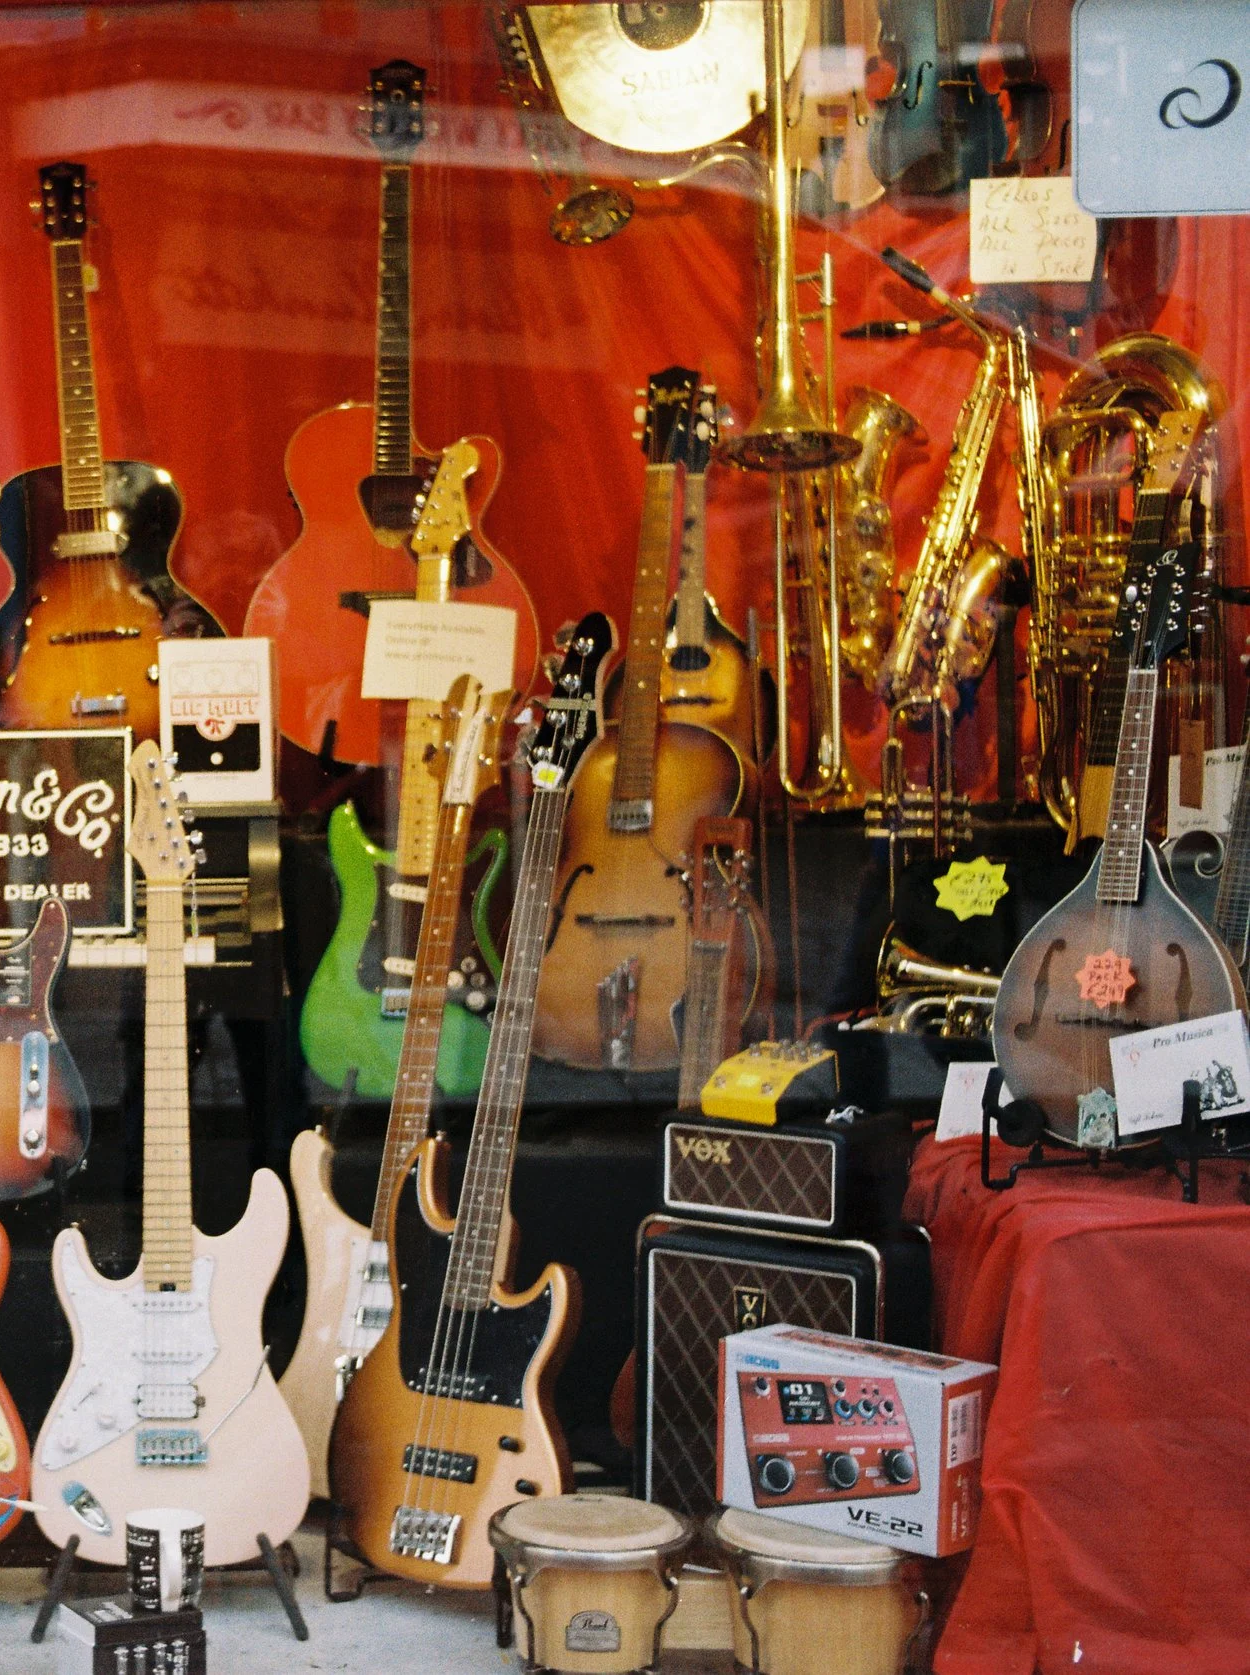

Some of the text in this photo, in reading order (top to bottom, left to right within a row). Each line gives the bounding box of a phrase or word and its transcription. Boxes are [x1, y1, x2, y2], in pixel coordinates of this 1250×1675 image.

[620, 62, 719, 97] SABIAN
[1152, 1028, 1214, 1049] Pro Musica
[674, 1136, 732, 1165] VOX
[847, 1505, 924, 1539] VE-22
